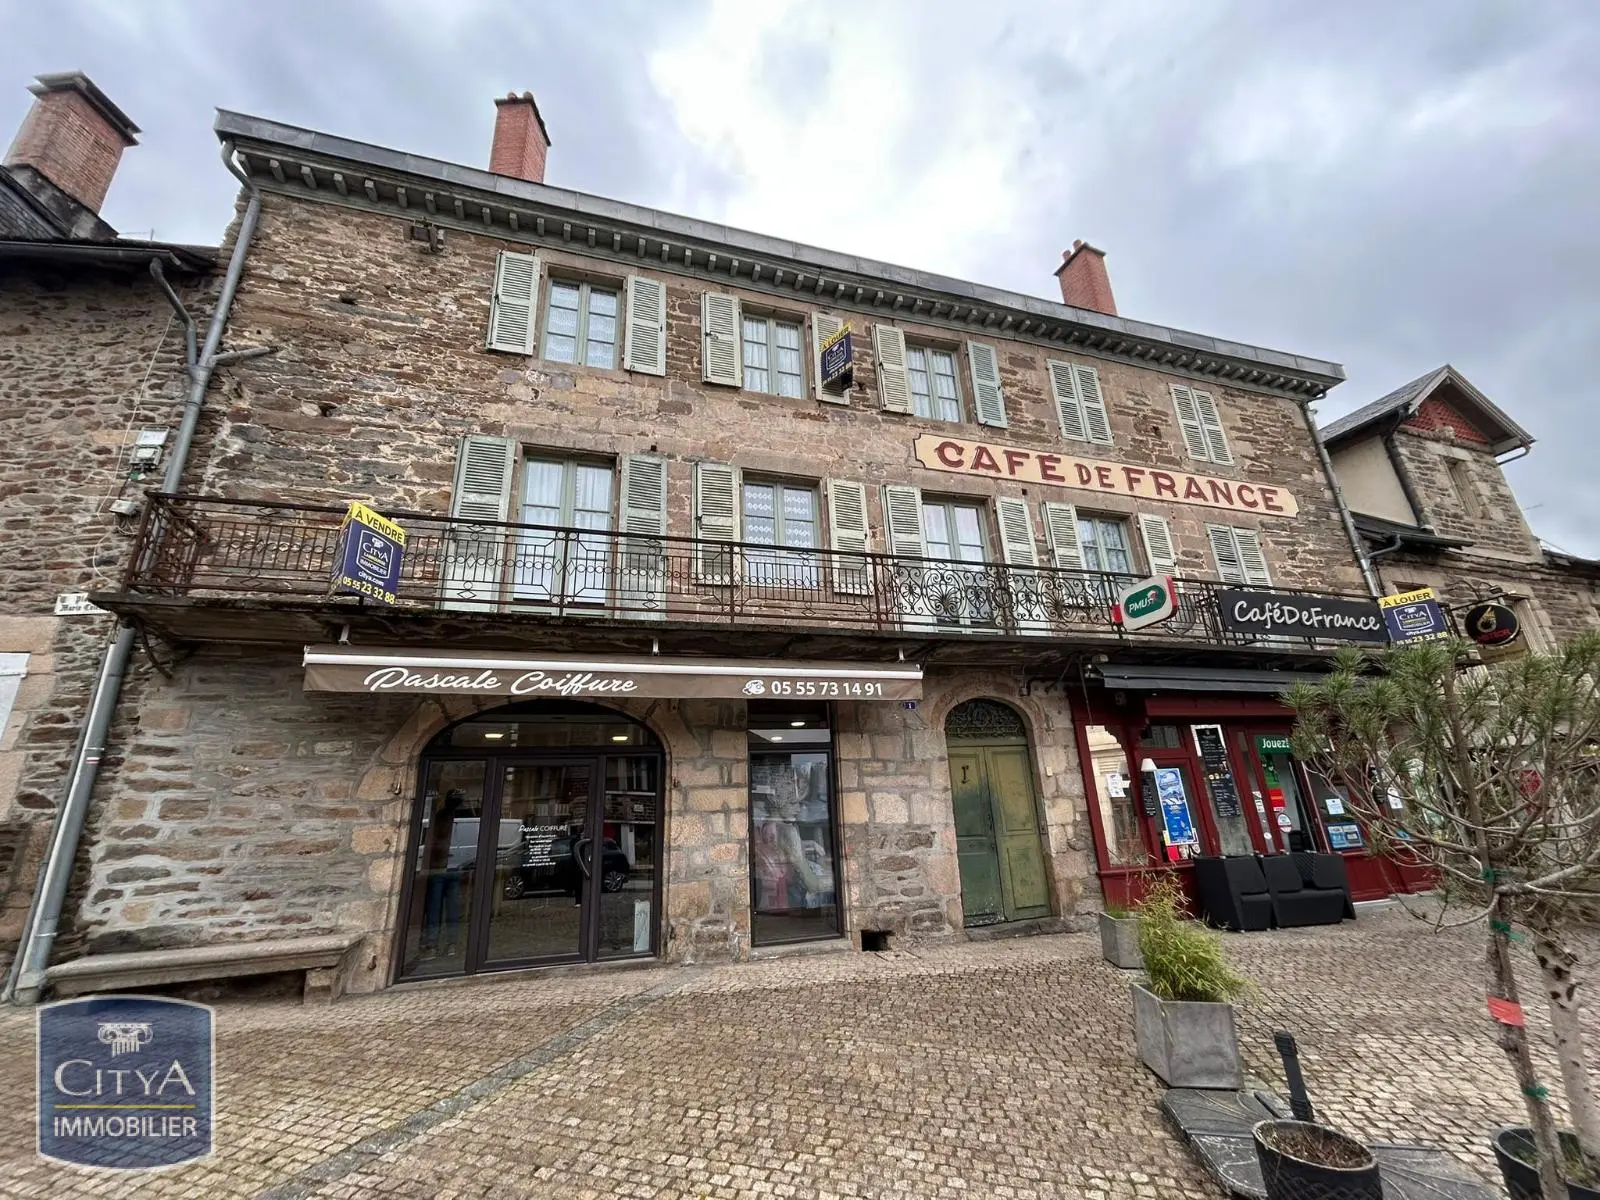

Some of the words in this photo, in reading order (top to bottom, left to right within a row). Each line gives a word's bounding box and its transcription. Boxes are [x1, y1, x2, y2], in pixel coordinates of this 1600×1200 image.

[1074, 463, 1115, 489] DE
[1121, 466, 1284, 512] FRANCE
[367, 514, 404, 543] VENDRE
[343, 576, 352, 586] 05
[353, 580, 361, 590] 55
[361, 582, 372, 595] 23
[373, 587, 383, 600] 32
[385, 592, 396, 605] 88
[358, 570, 385, 587] citya.com
[1129, 598, 1149, 613] PMU
[1394, 592, 1432, 605] LOUER
[1234, 600, 1380, 630] CaféDeFrance
[364, 667, 503, 692] Pascale
[510, 671, 638, 695] Coiffure
[771, 681, 791, 695] 05
[796, 681, 816, 695] 55
[820, 681, 839, 696] 73
[844, 682, 862, 696] 14
[866, 682, 882, 696] 91
